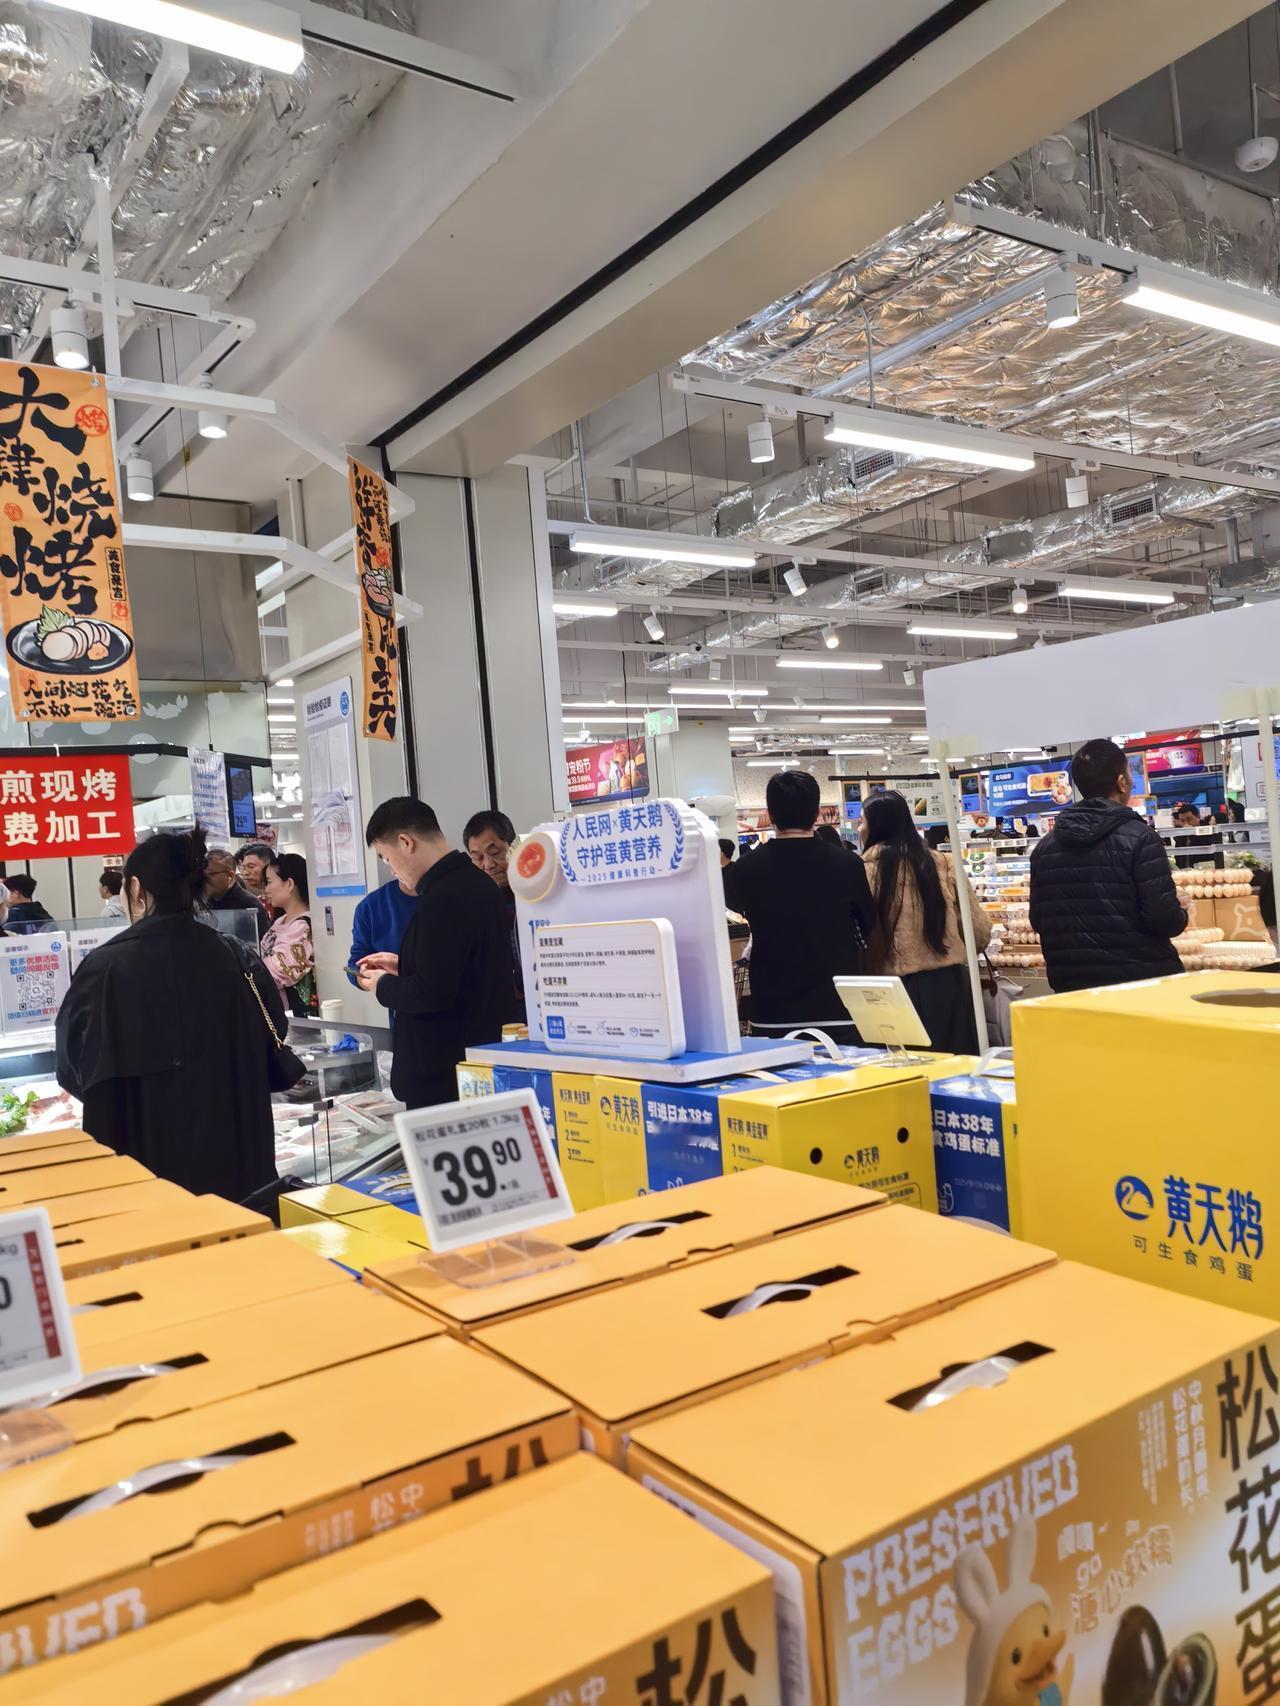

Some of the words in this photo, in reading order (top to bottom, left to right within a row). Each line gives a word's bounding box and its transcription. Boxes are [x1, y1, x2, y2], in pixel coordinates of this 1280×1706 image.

[4, 811, 121, 847] 费加工
[576, 834, 662, 869] 守护蛋黄营养
[1163, 1174, 1264, 1260] 黄天鹅
[1132, 1234, 1254, 1282] 可生食鸡蛋
[840, 1443, 1079, 1622] PRESERVED
[847, 1582, 959, 1696] EGGS
